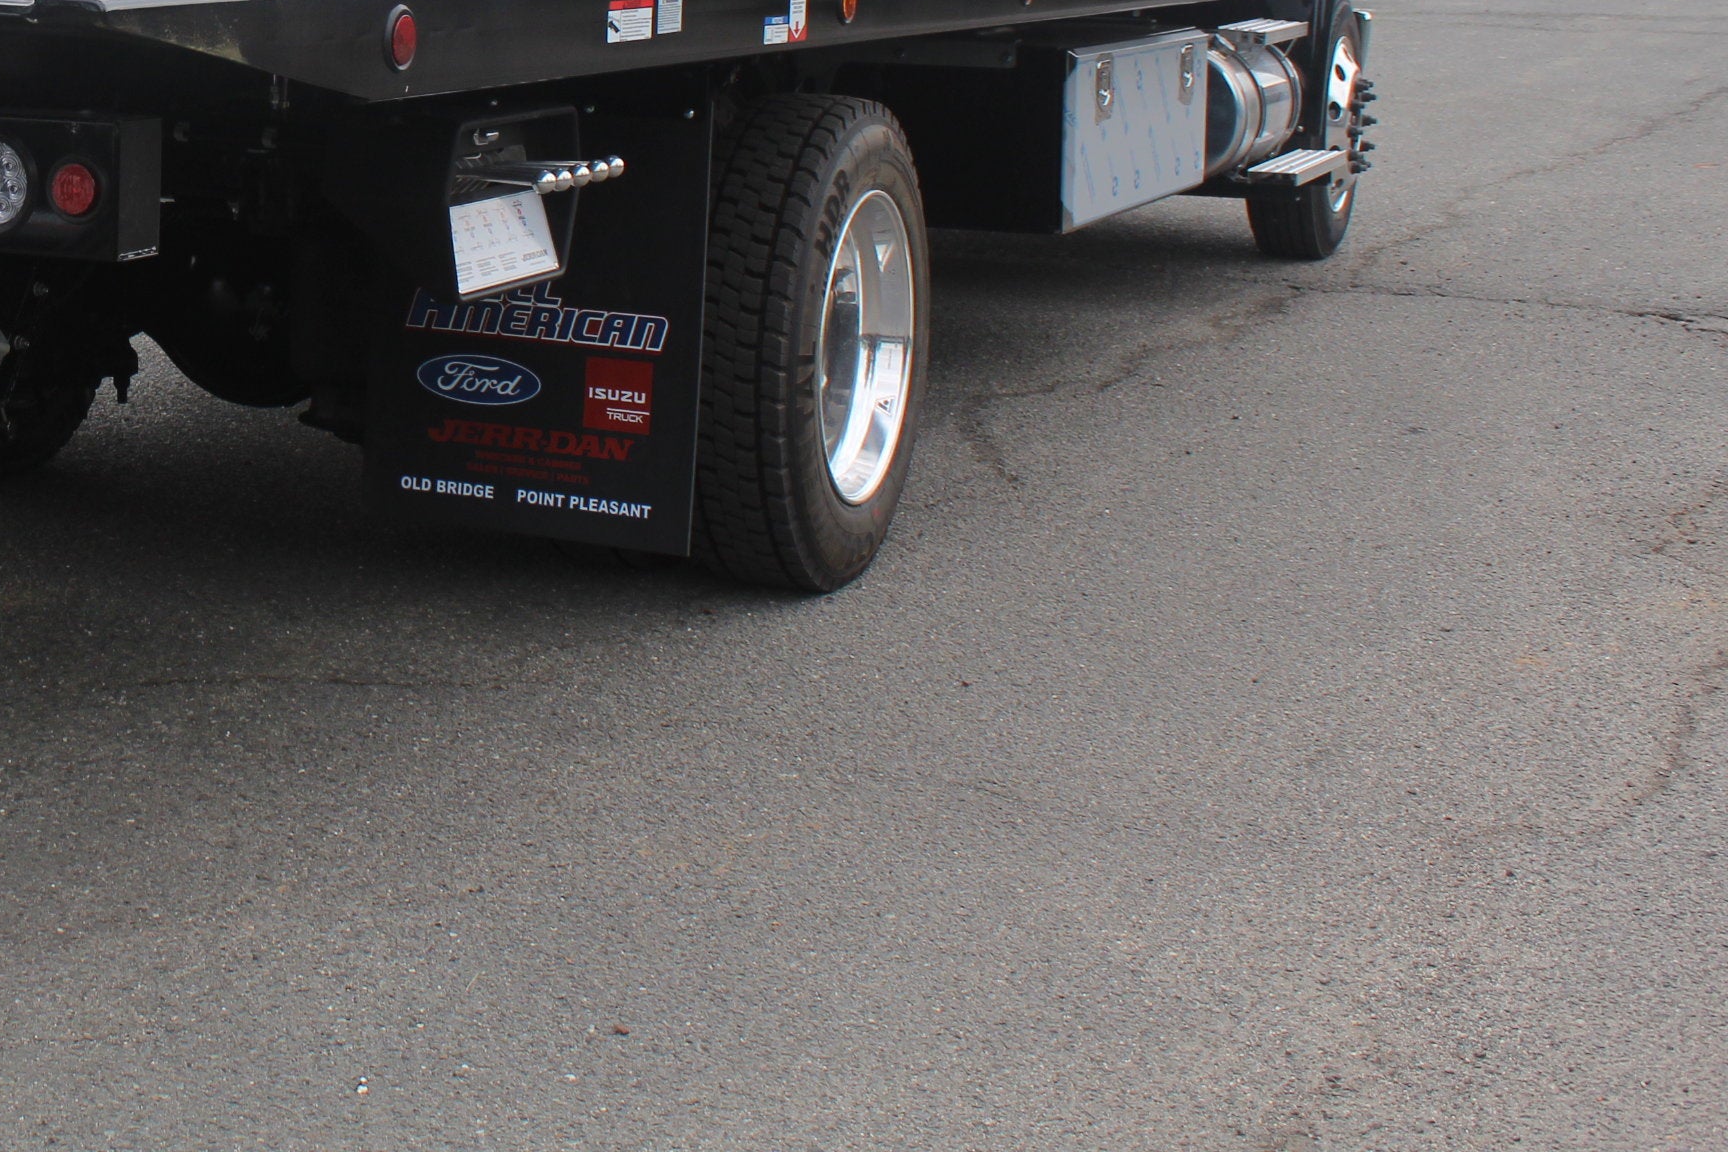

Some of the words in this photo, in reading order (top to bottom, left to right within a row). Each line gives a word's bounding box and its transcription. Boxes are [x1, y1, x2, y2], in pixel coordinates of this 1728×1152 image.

[406, 287, 669, 352] AMERICAN
[437, 361, 522, 396] Ford
[588, 386, 647, 405] ISUZU
[606, 411, 644, 424] TRUCK
[400, 475, 432, 492] OLD
[436, 479, 495, 499] BRIDGE
[517, 489, 566, 509] POINT
[569, 495, 652, 520] PLEASANT
